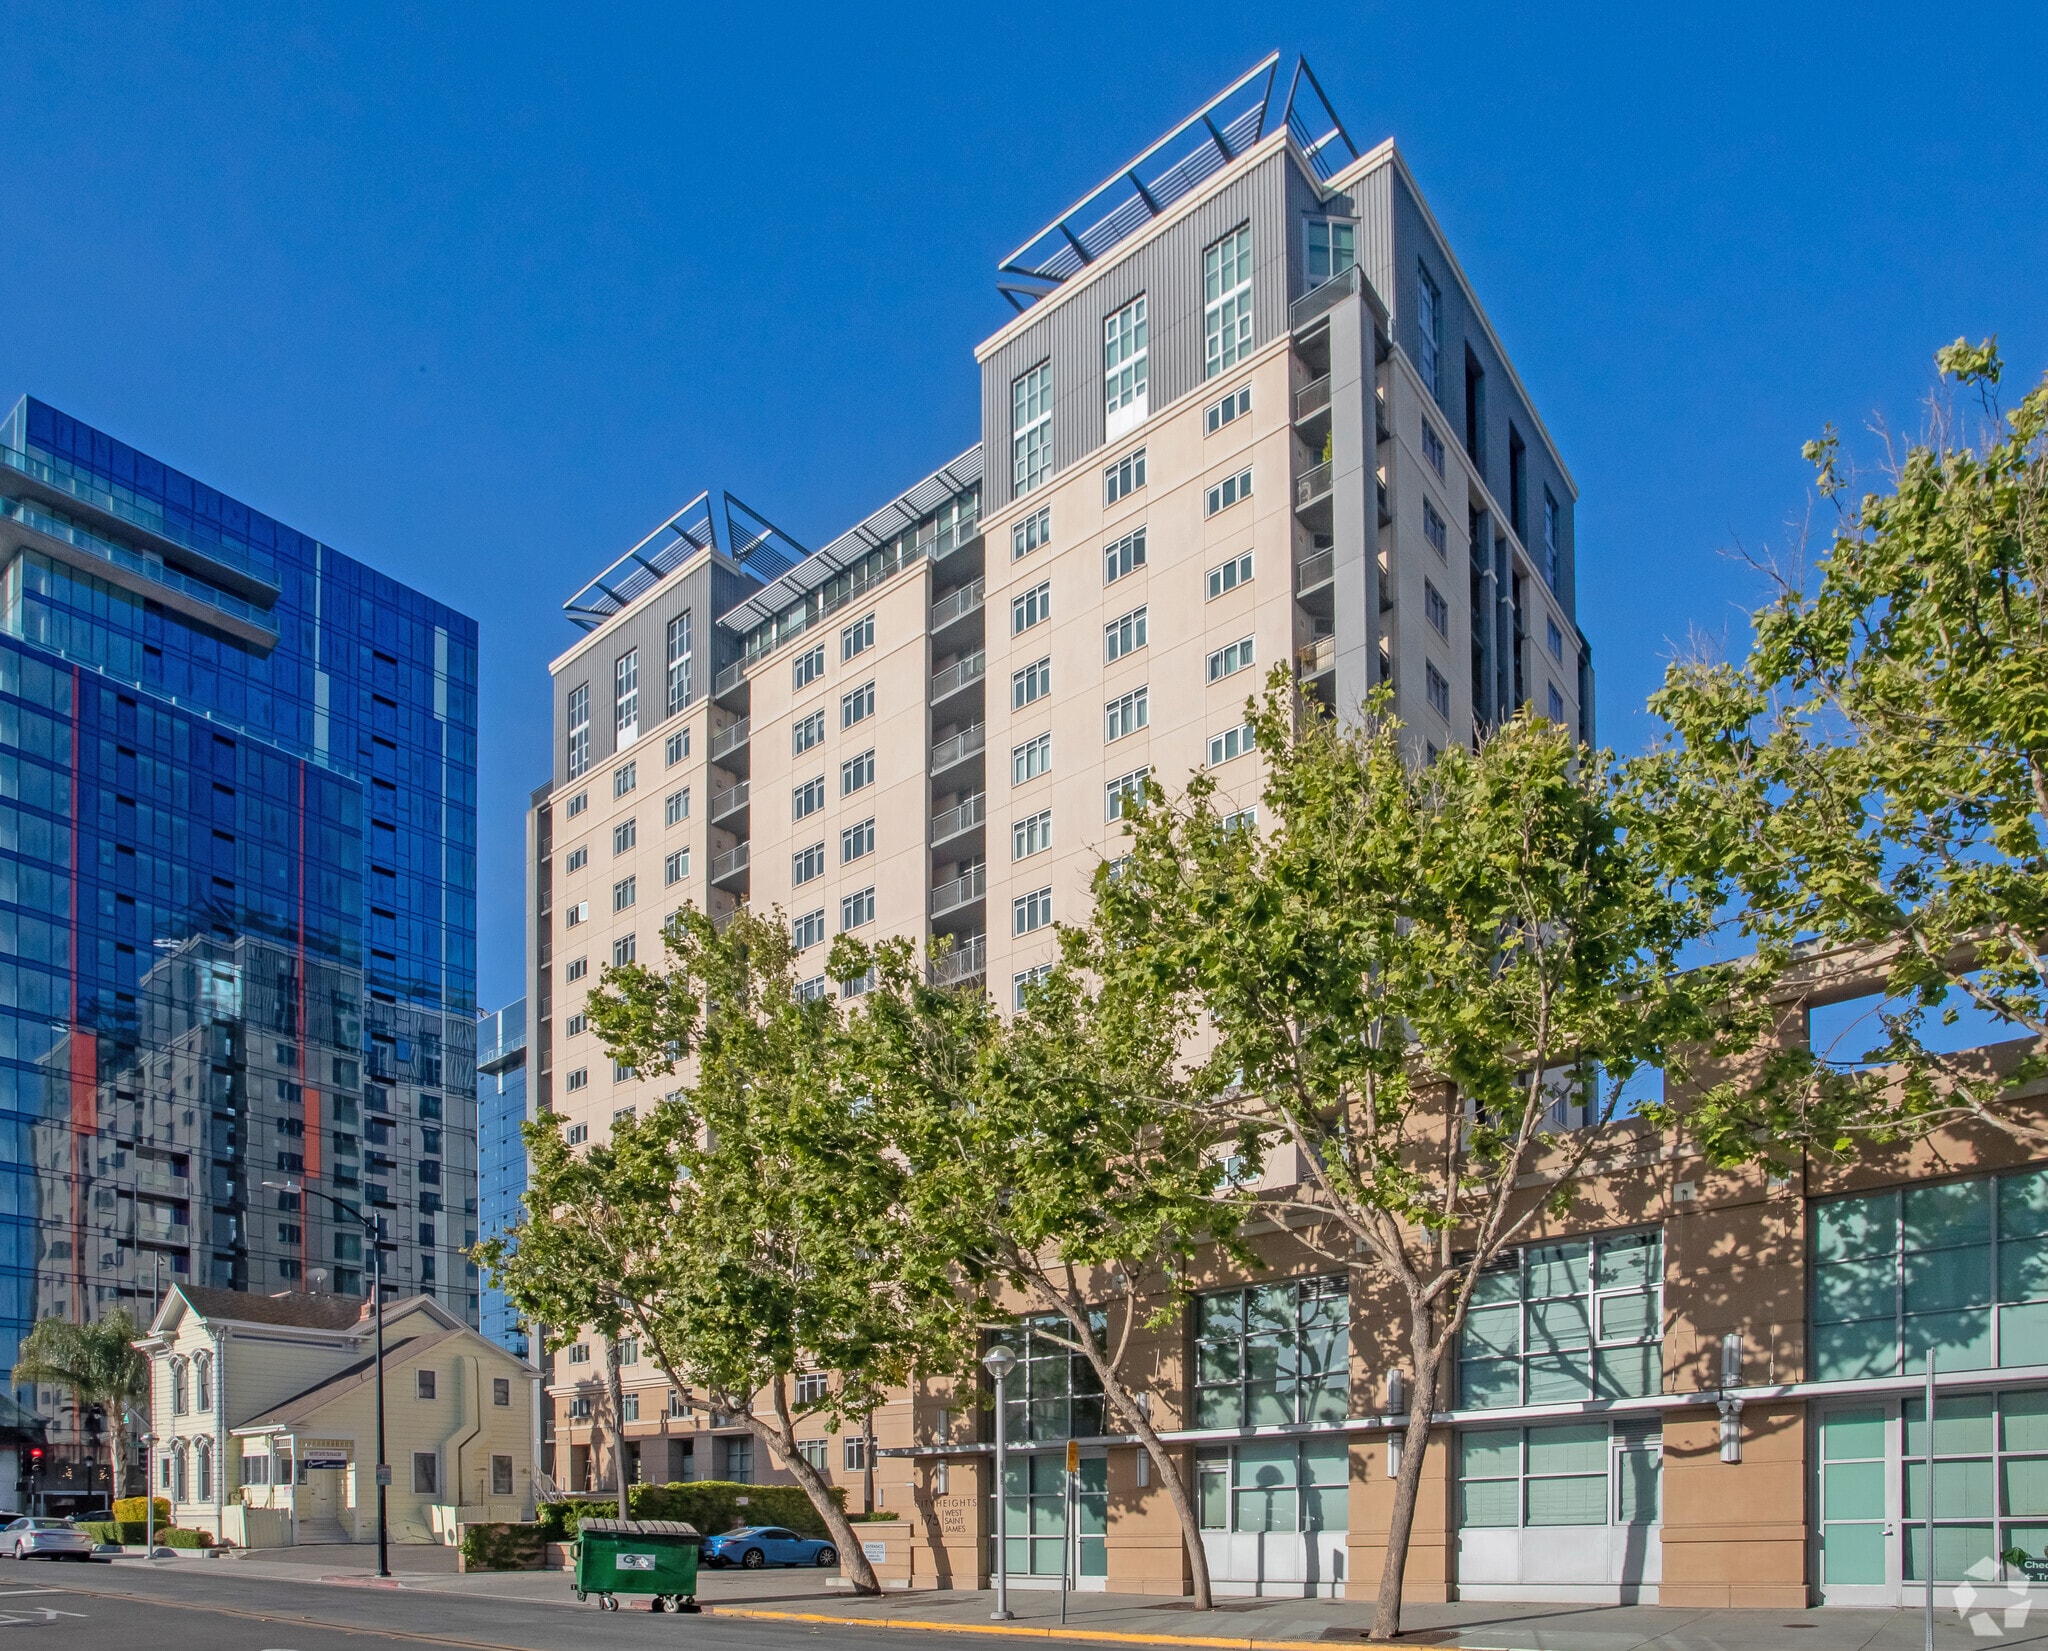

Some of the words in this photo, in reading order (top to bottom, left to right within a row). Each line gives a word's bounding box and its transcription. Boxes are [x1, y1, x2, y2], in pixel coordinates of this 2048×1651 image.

[914, 1499, 934, 1508] CITY
[936, 1498, 977, 1507] HEIGHTS
[920, 1514, 940, 1526] 175
[944, 1517, 965, 1525] SAINT
